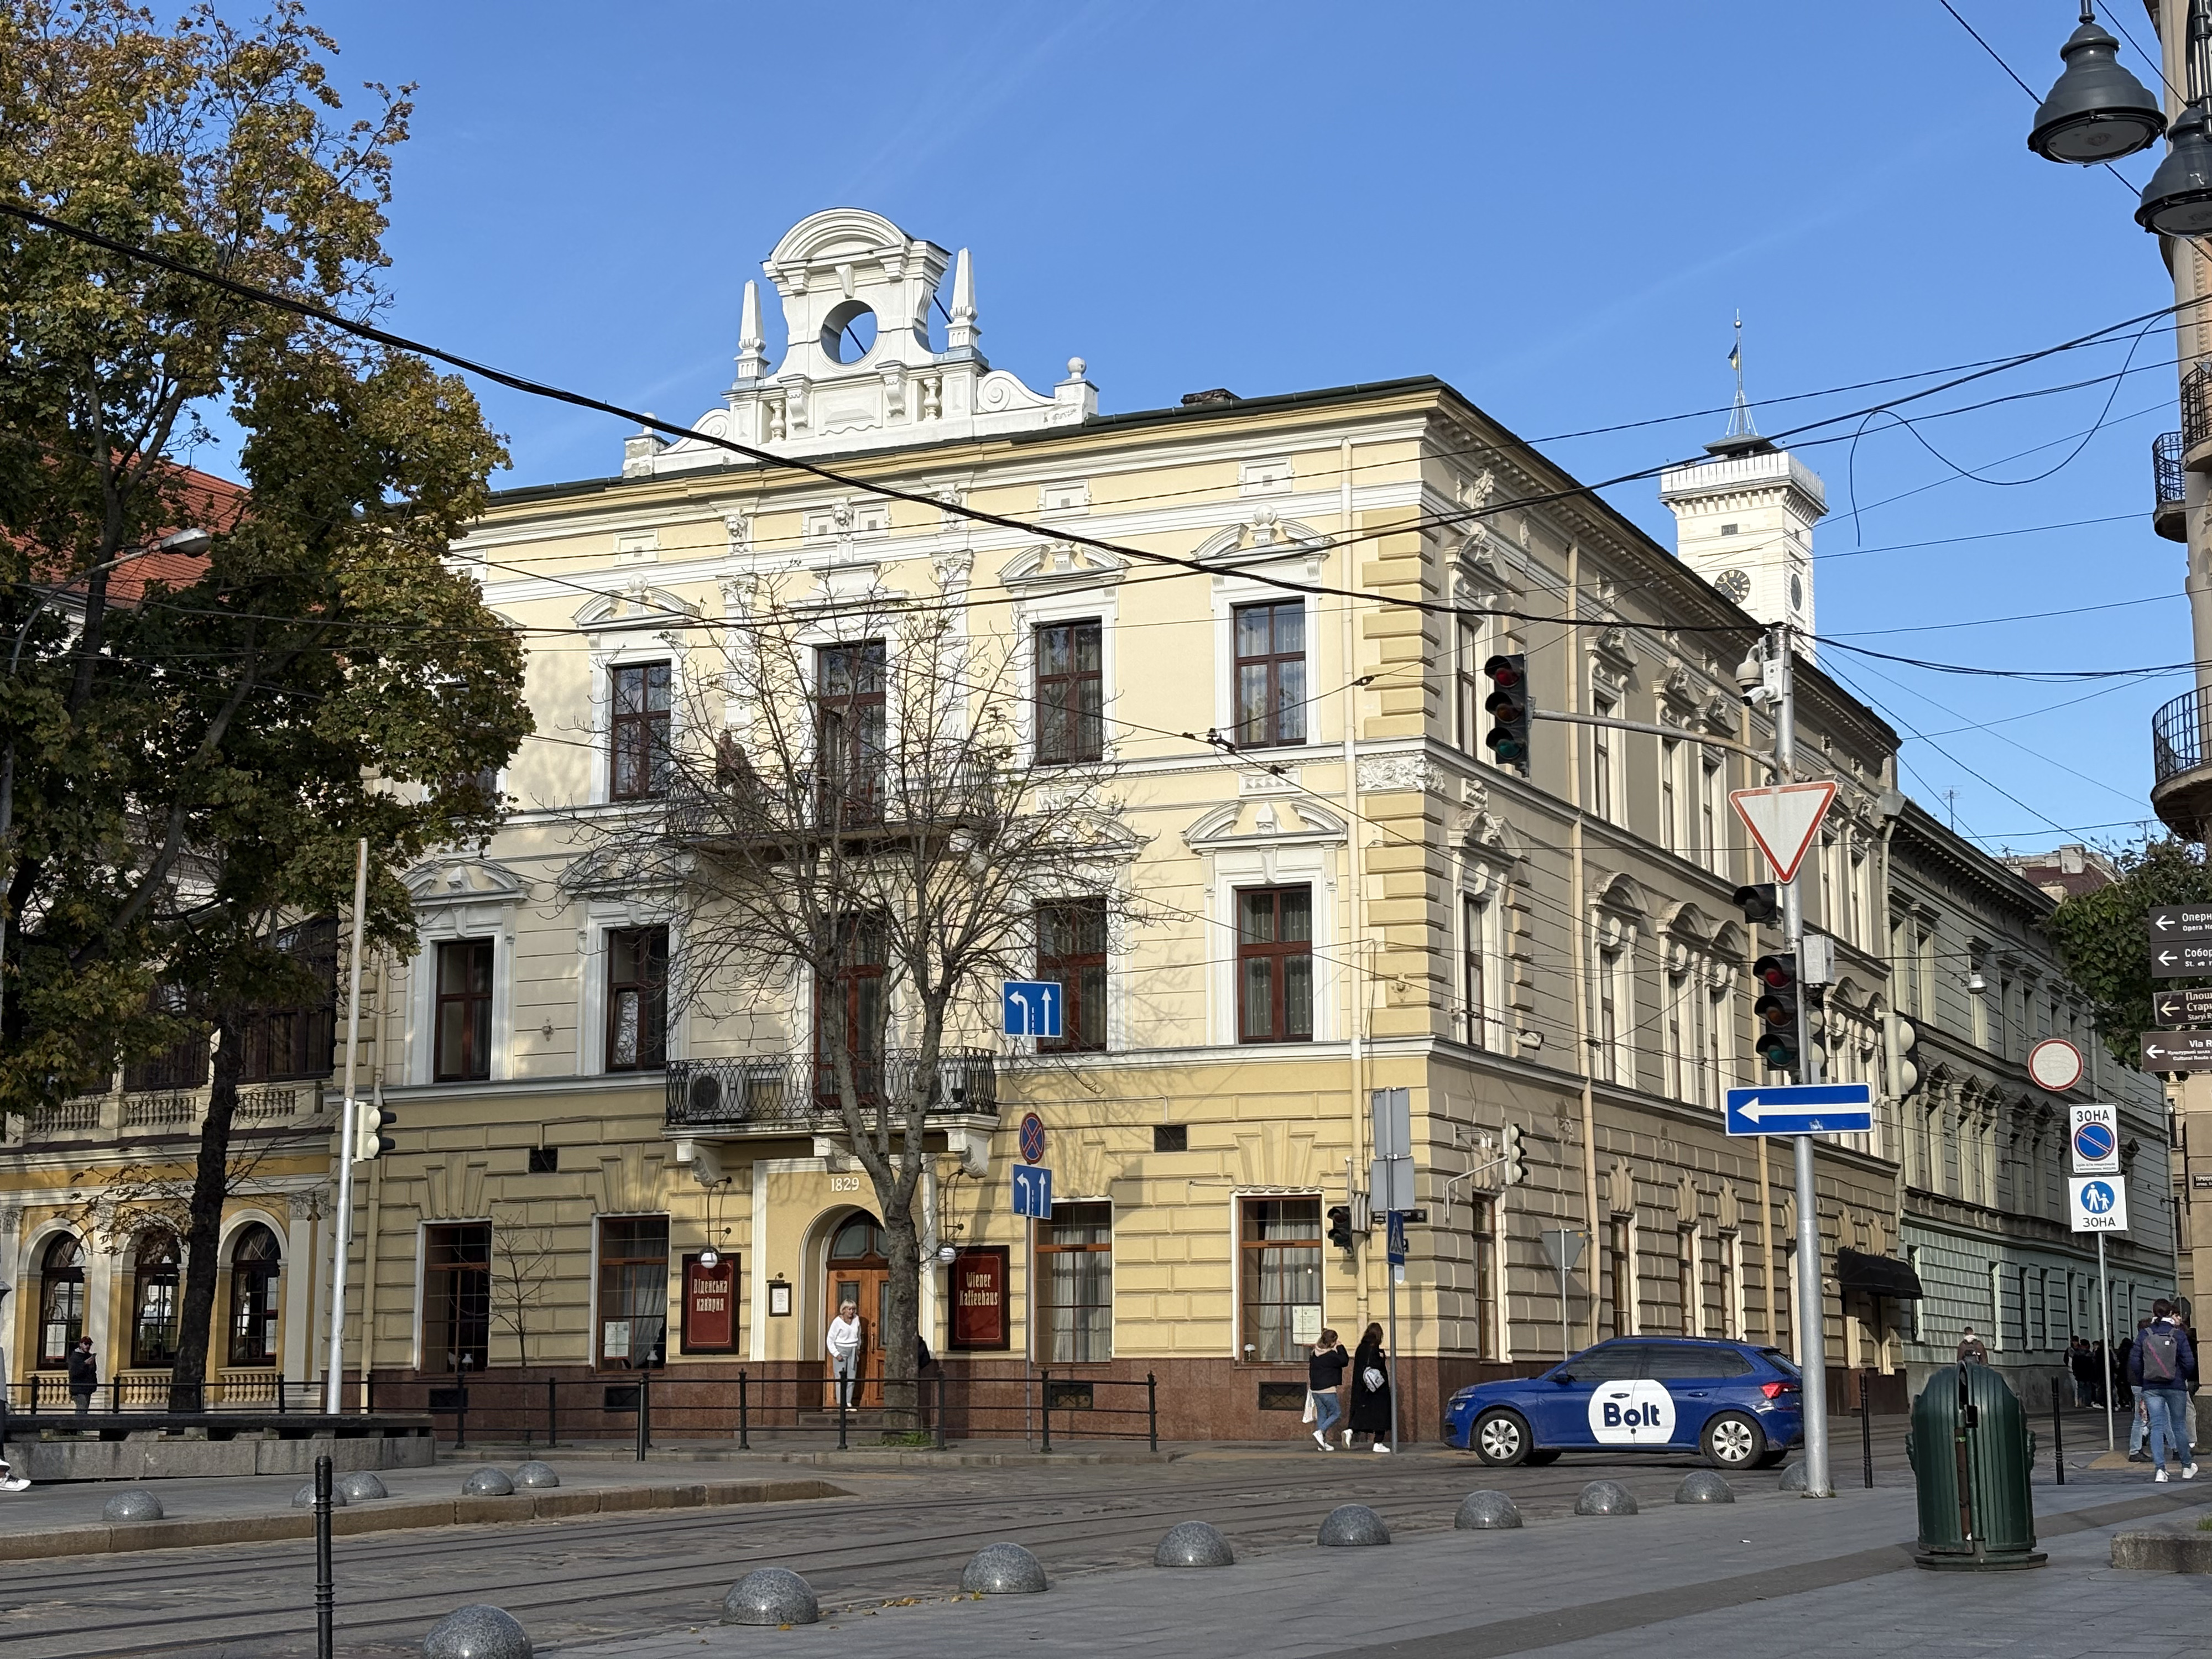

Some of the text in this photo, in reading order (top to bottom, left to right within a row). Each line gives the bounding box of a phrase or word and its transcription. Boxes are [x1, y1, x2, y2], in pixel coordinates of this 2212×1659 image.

[2077, 1109, 2110, 1122] ЗОНА
[831, 1177, 859, 1192] 1829
[2083, 1217, 2116, 1228] ЗОНА
[966, 1272, 991, 1288] Wiener
[959, 1290, 998, 1306] Kaffeehaus
[1603, 1401, 1660, 1427] Bolt
